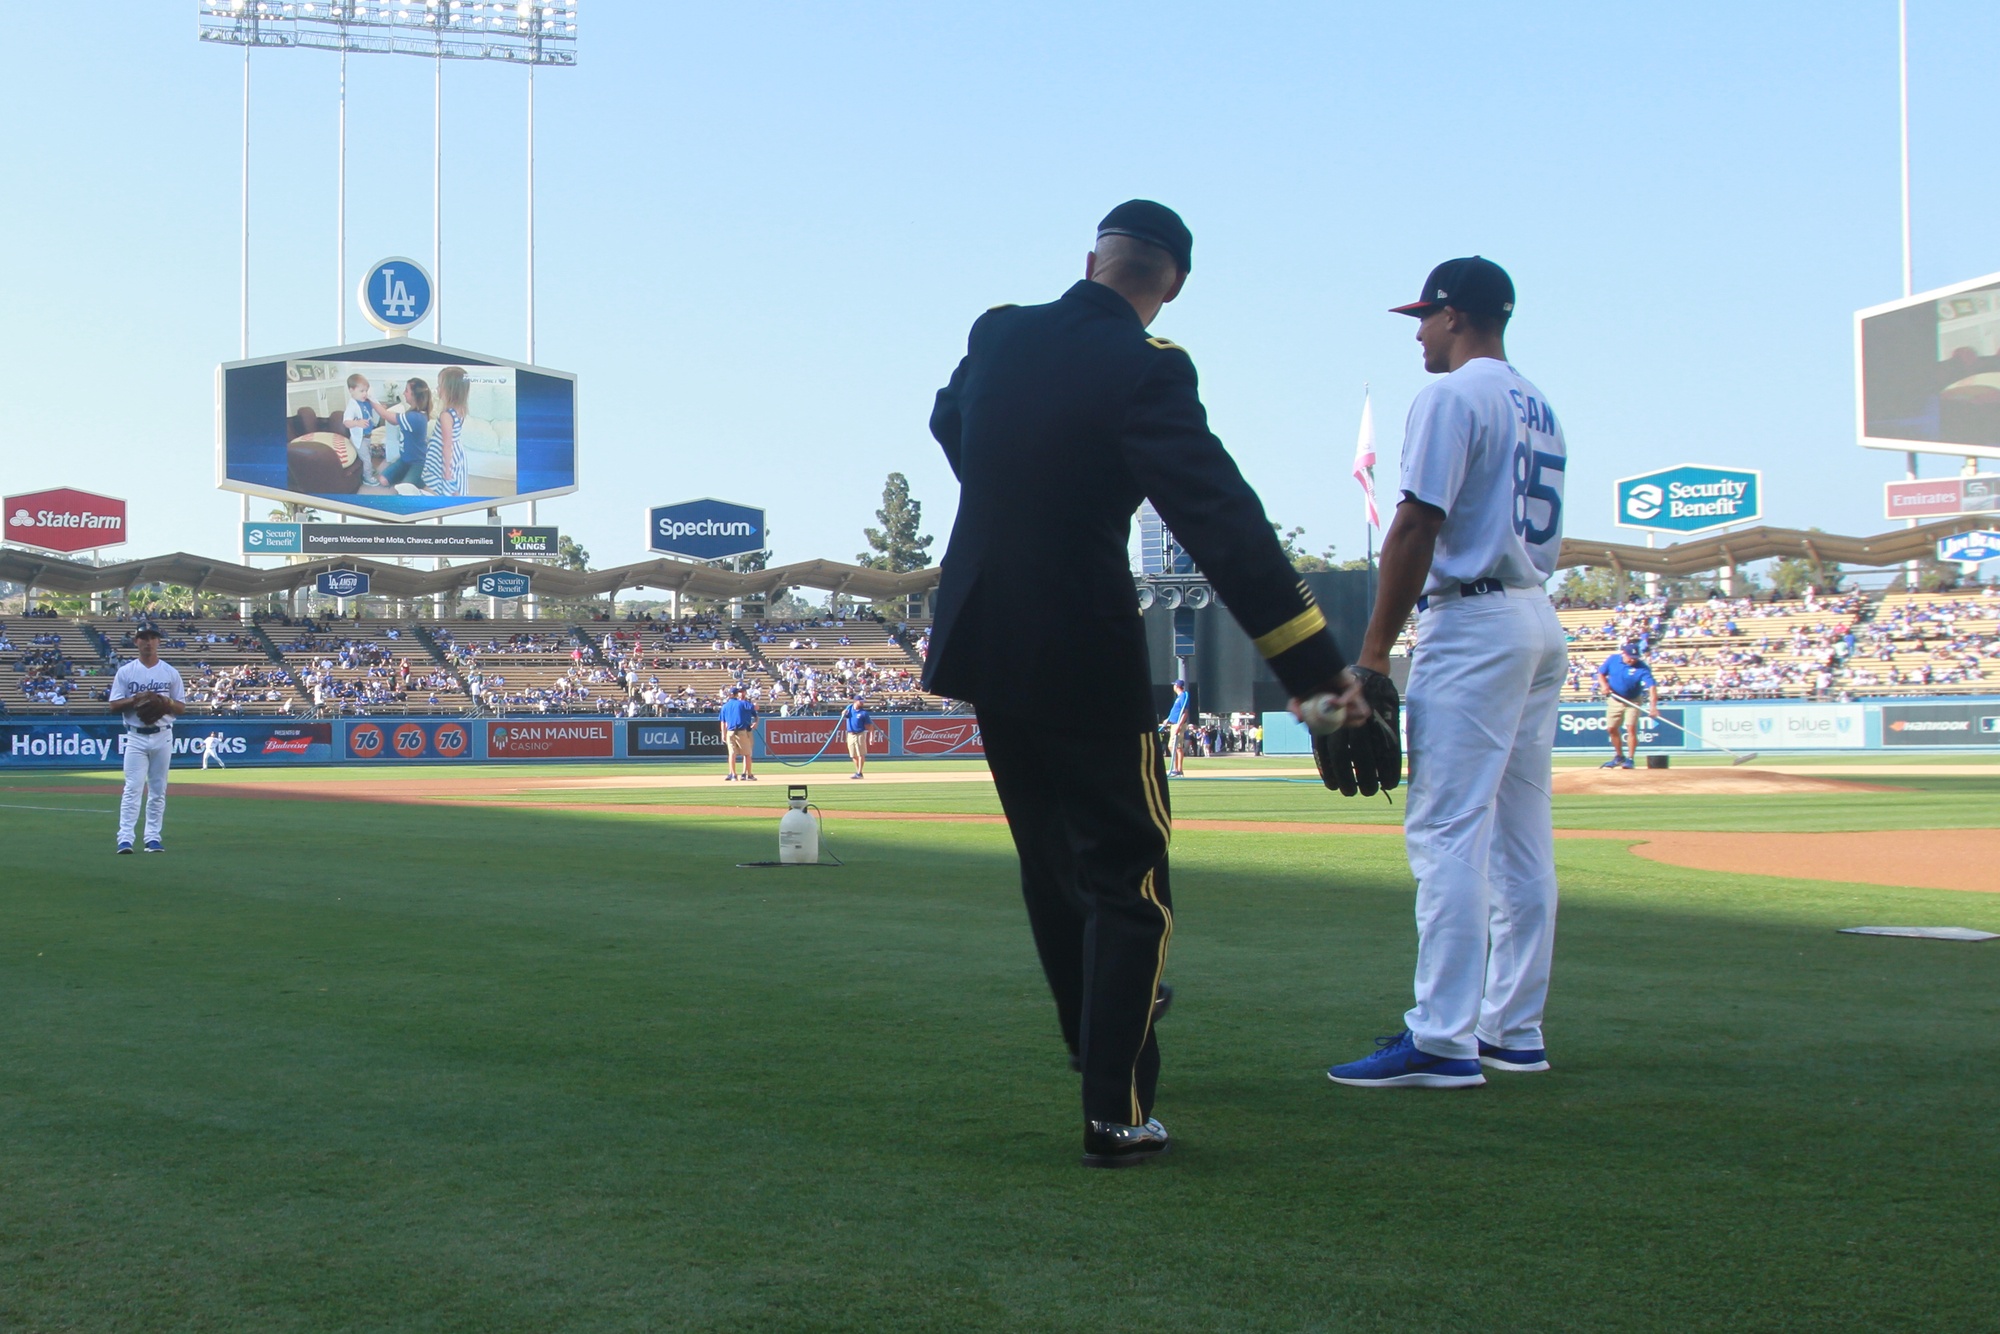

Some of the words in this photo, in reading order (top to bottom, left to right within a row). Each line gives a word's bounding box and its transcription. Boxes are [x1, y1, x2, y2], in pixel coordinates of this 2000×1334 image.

[382, 269, 415, 317] LA
[1509, 389, 1554, 436] SAN
[1512, 440, 1567, 545] 85
[1668, 478, 1748, 499] Security
[1892, 492, 1957, 507] Emirates
[1669, 498, 1739, 518] Benefit
[265, 529, 297, 540] Security
[659, 518, 750, 540] Spectrum
[265, 538, 293, 546] Benefit
[309, 535, 338, 544] Dodgers
[340, 536, 373, 544] Welcome
[386, 537, 405, 545] Mota,
[406, 537, 433, 545] Chavez,
[511, 536, 547, 544] DRAFT
[515, 542, 546, 550] KINGS
[497, 577, 525, 587] Security
[497, 585, 522, 593] Benefit
[1712, 717, 1753, 732] blue
[1788, 716, 1831, 731] blue
[354, 729, 380, 751] 76
[397, 729, 422, 750] 76
[438, 729, 463, 750] 76
[510, 728, 541, 740] SAN
[545, 727, 608, 740] MANUEL
[644, 732, 680, 745] UCLA
[770, 731, 829, 744] Emirates
[912, 730, 961, 741] Budweiser
[12, 733, 111, 761] Holiday
[265, 740, 309, 750] Budweiser
[510, 742, 550, 751] CASINO
